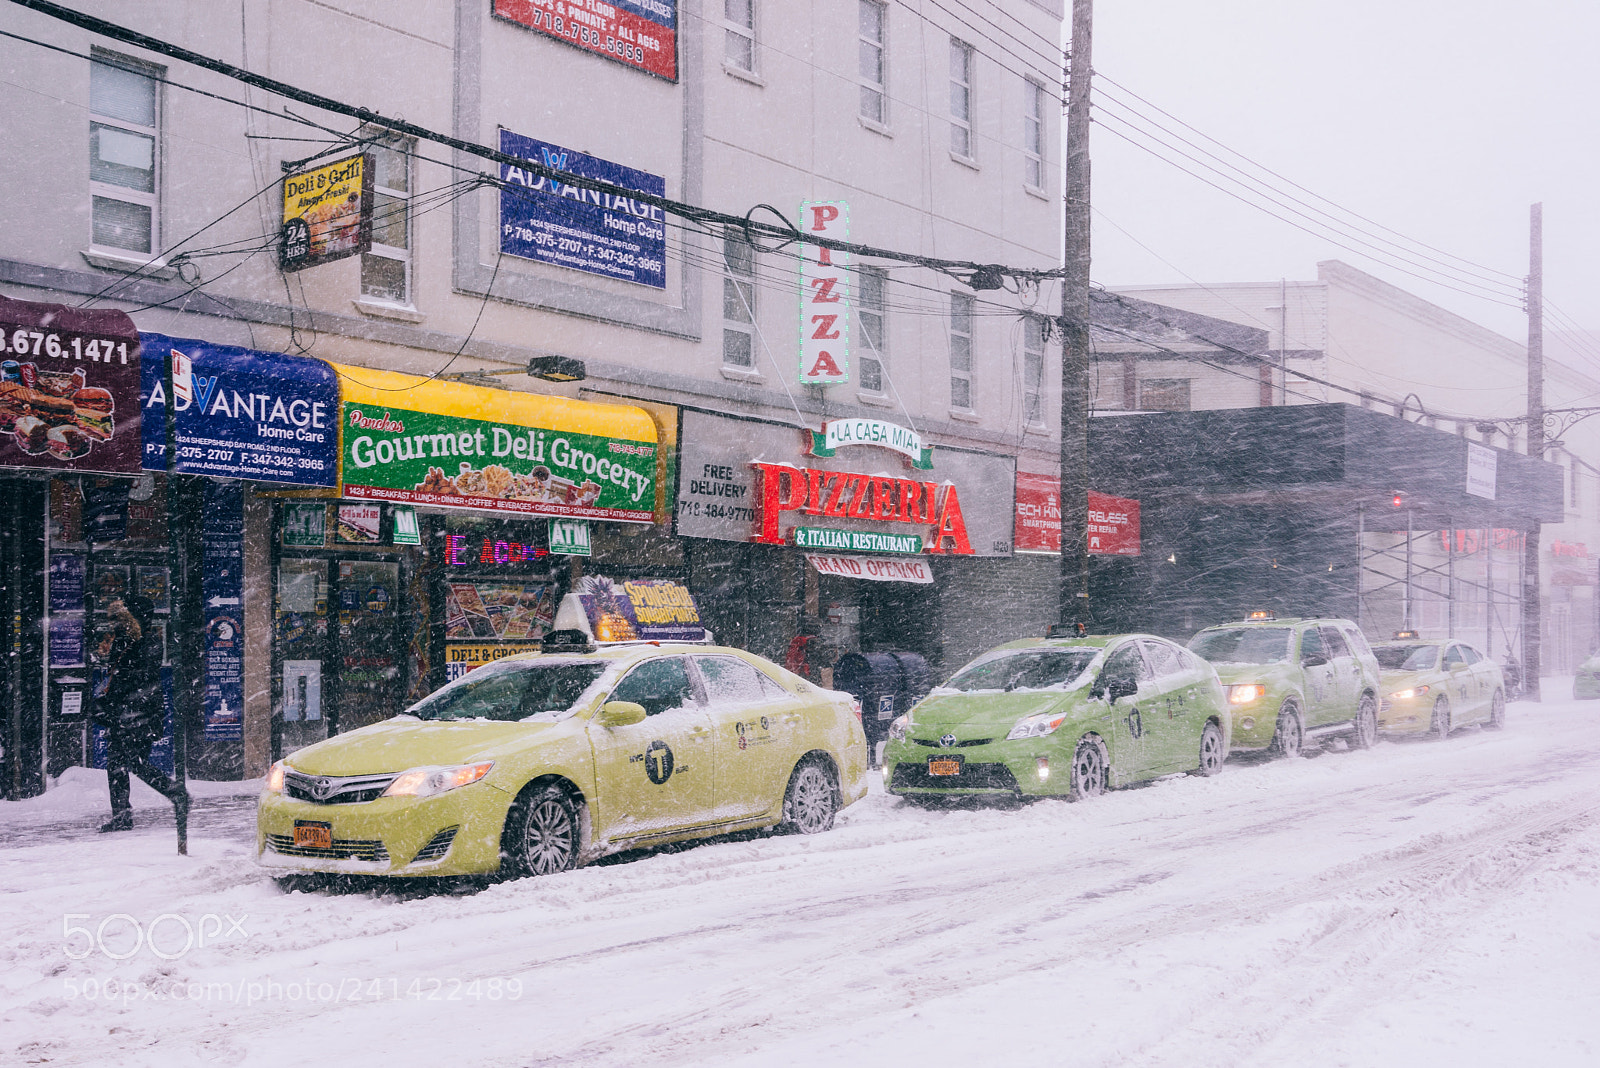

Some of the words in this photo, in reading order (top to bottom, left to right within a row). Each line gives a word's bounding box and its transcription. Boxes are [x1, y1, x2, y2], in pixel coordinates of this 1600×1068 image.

[533, 7, 644, 63] 718.758.5959
[568, 5, 606, 31] PRIVATE
[618, 25, 635, 42] ALL
[637, 33, 660, 52] AGES
[287, 177, 315, 198] Deli
[317, 174, 326, 188] &
[329, 162, 360, 184] Grill
[287, 223, 307, 245] 24
[604, 213, 637, 234] Home
[637, 222, 664, 241] Care
[622, 242, 641, 253] FLOOR
[807, 205, 844, 377] PIZZA
[258, 424, 294, 440] Home
[296, 428, 325, 443] Care
[836, 423, 852, 441] LA
[855, 423, 887, 443] CASA
[893, 429, 914, 450] MIA
[234, 441, 247, 449] BAY
[280, 446, 301, 455] FLOOR
[352, 427, 486, 469] Gourmet
[491, 427, 545, 463] Deli
[551, 438, 650, 502] Grocery
[703, 463, 733, 481] FREE
[690, 479, 747, 498] DELIVERY
[371, 489, 411, 500] BREAKFAST
[414, 493, 437, 502] LUNCH
[441, 496, 464, 505] DINNER
[467, 498, 493, 507] COFFEE
[497, 501, 532, 511] BEVERAGES
[535, 503, 570, 514] CIGARETTES
[573, 507, 609, 517] SANDWICHES
[612, 509, 625, 518] ATM
[627, 511, 653, 520] GROCERY
[755, 462, 976, 555] PIZZERIA
[1016, 502, 1041, 517] TECH
[1044, 506, 1062, 519] KIN
[551, 522, 589, 547] ATM
[796, 530, 806, 546] &
[807, 529, 851, 549] ITALIAN
[852, 533, 918, 552] RESTAURANT
[809, 555, 861, 576] GRAND
[867, 558, 924, 580] OPENING
[451, 648, 480, 662] DELI
[482, 648, 491, 661] &
